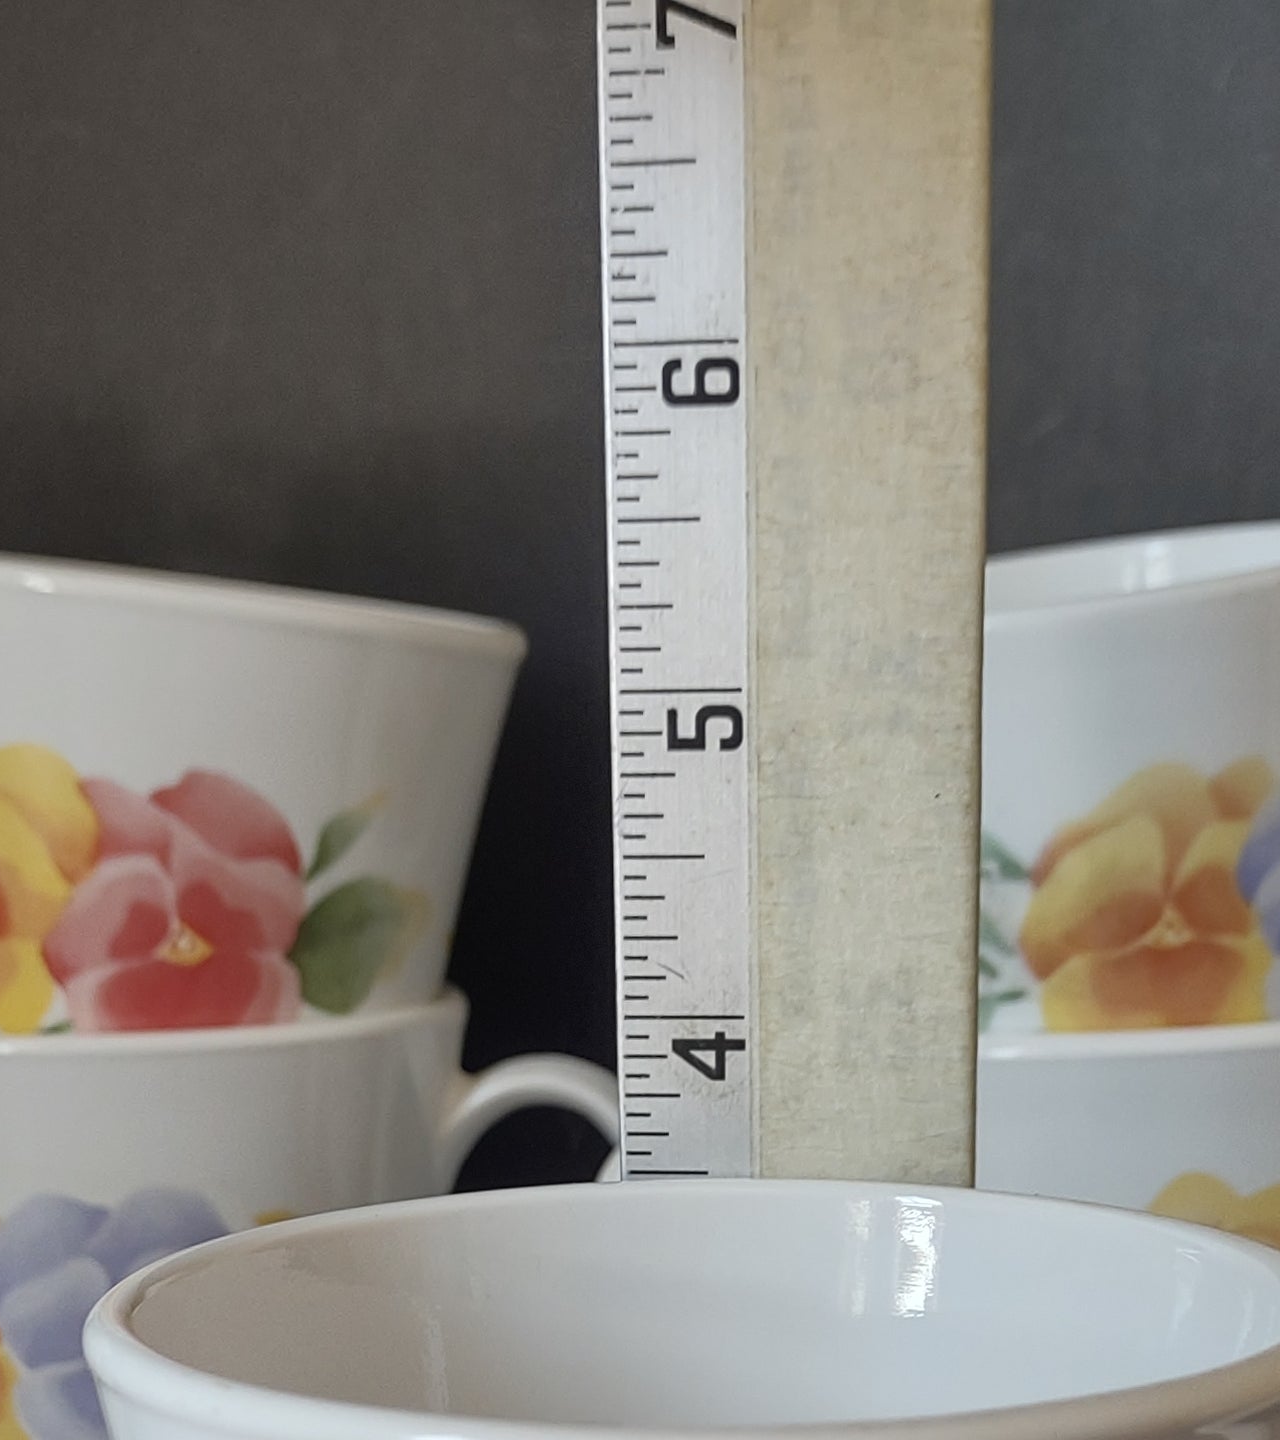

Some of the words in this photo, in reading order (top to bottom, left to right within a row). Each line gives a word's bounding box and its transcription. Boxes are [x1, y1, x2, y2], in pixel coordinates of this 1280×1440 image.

[655, 0, 737, 49] 7
[662, 357, 740, 407] 6
[667, 704, 743, 751] 5
[671, 1031, 746, 1081] 4
